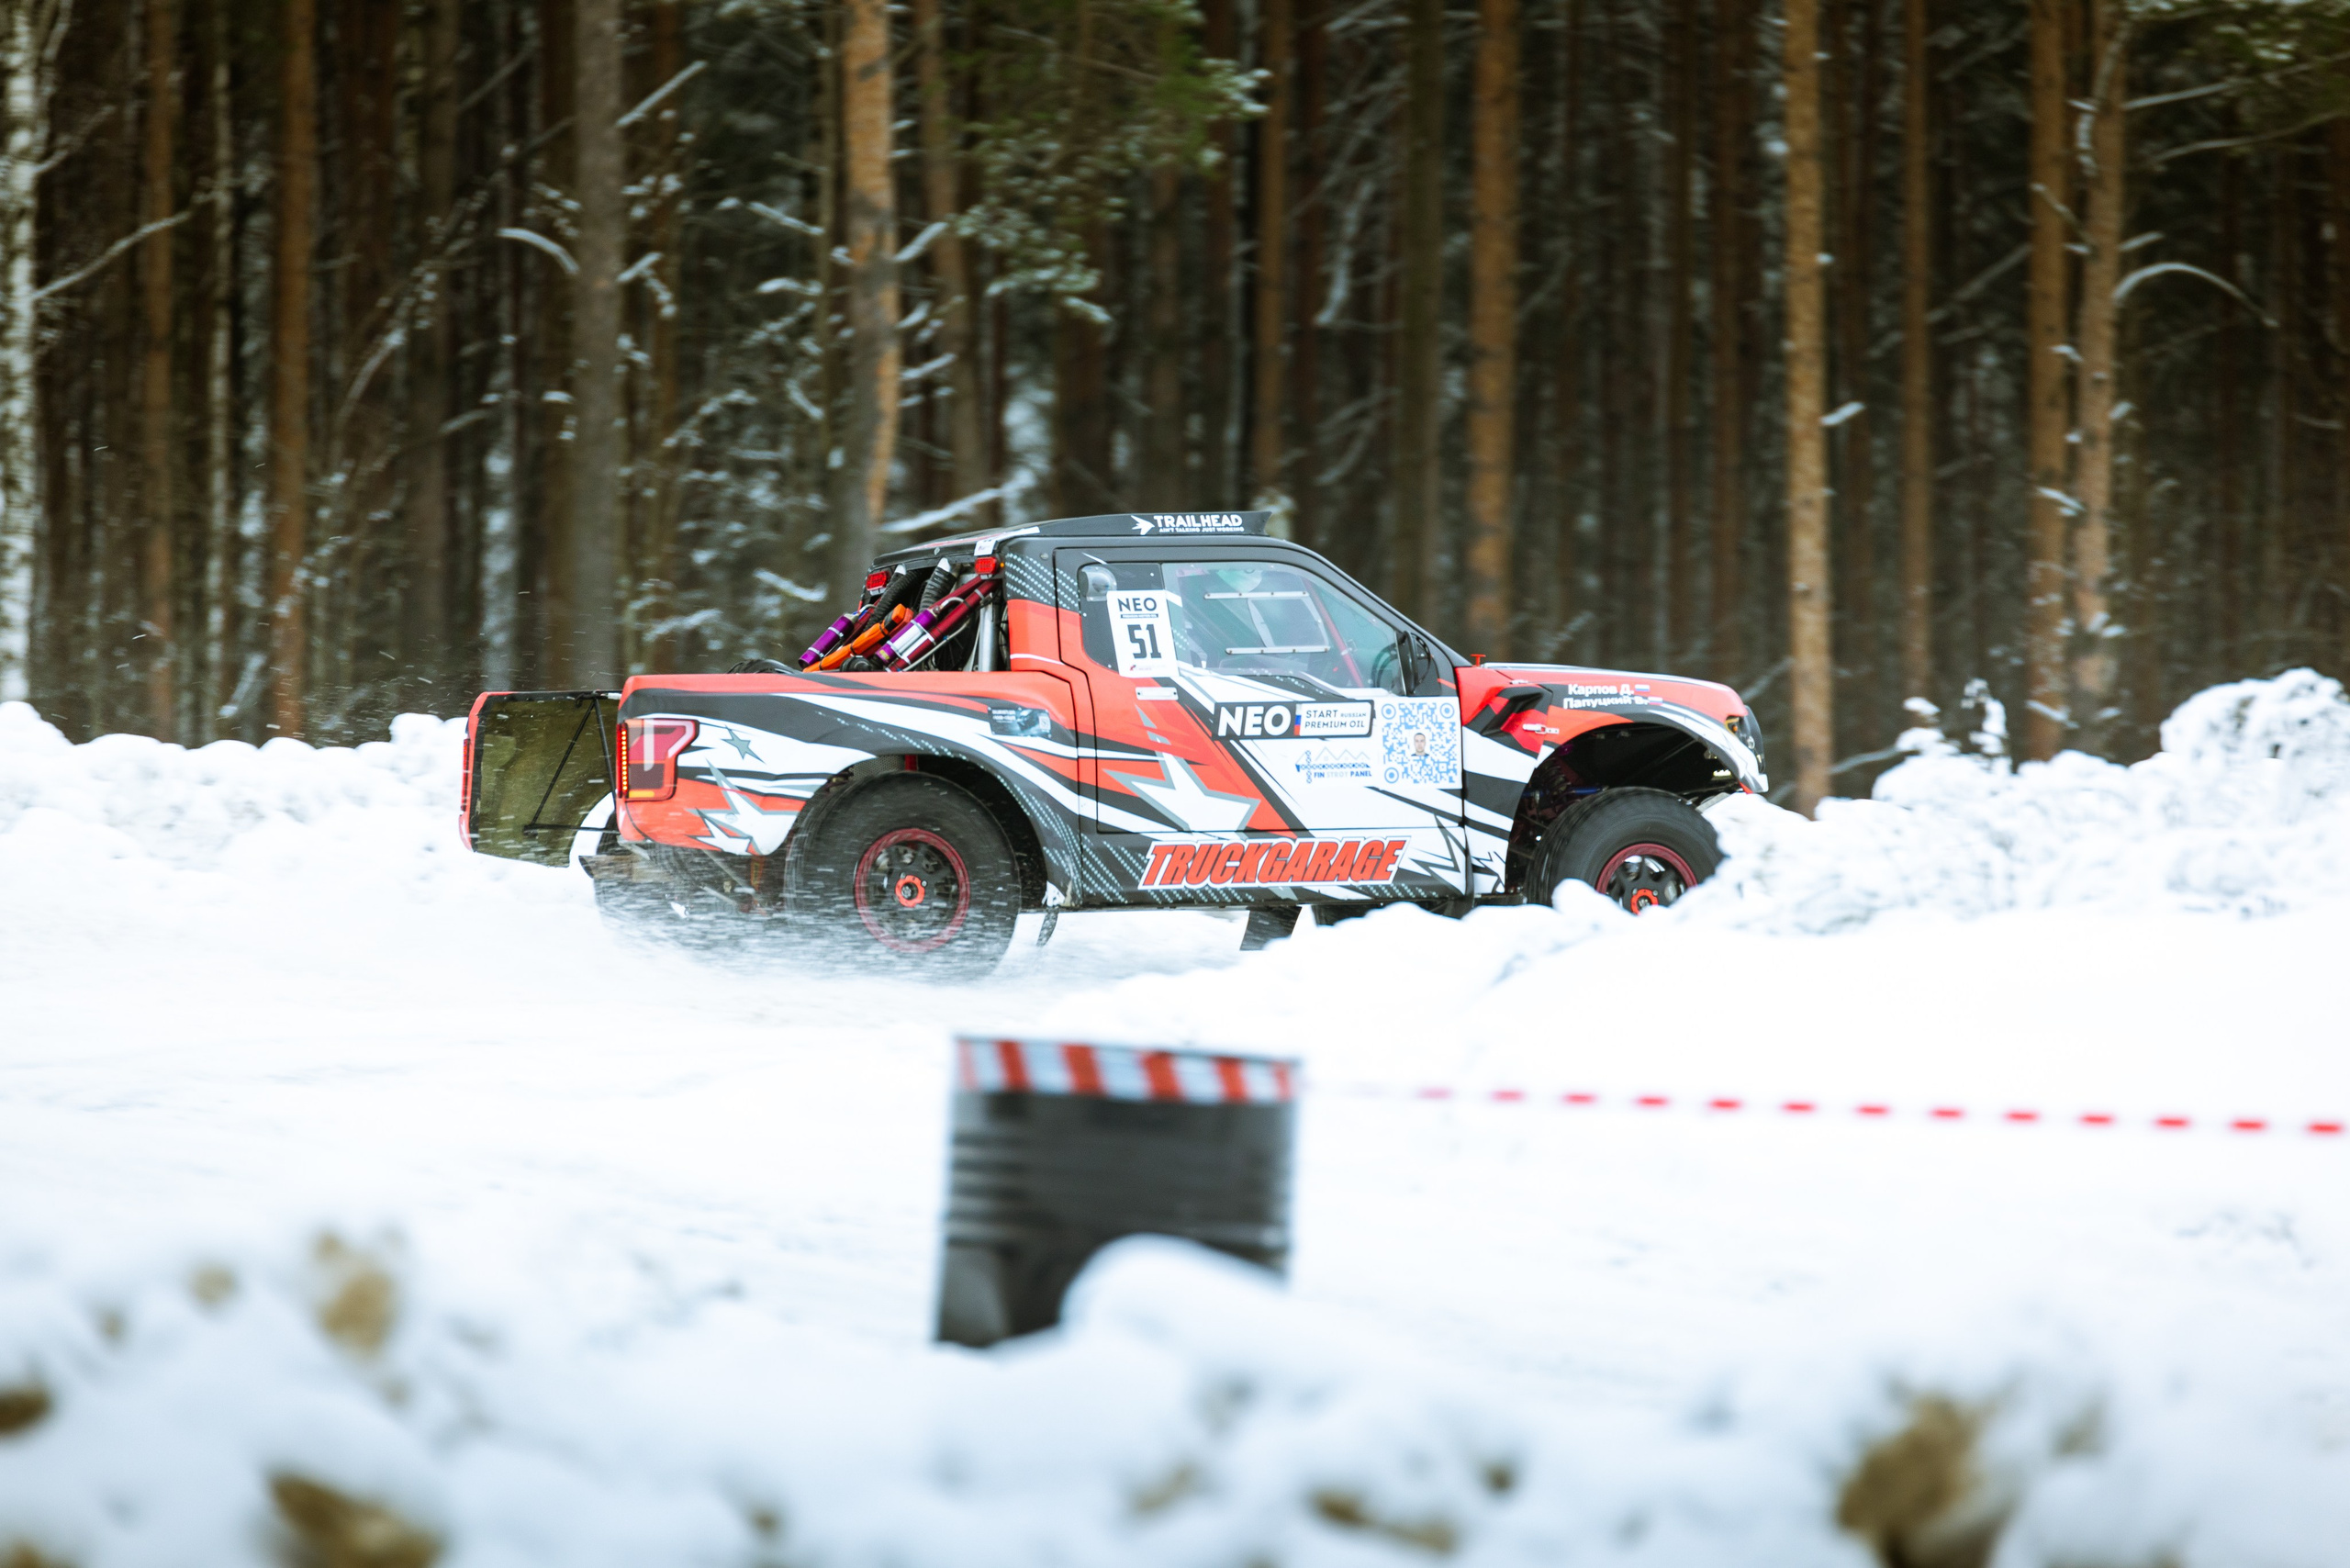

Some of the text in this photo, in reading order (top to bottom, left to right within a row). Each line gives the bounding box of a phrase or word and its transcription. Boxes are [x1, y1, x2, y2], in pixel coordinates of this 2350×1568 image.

[1153, 514, 1243, 528] TRAILHEAD
[1117, 597, 1158, 612] NEO
[1127, 623, 1162, 659] 51
[1568, 683, 1634, 697] Карпов Д.
[1563, 696, 1632, 710] Папуцкий
[1218, 705, 1292, 736] NEO
[1305, 710, 1339, 719] START
[1304, 720, 1365, 729] PREMIUM OIL
[1142, 839, 1407, 886] TRUCKGARAGE
